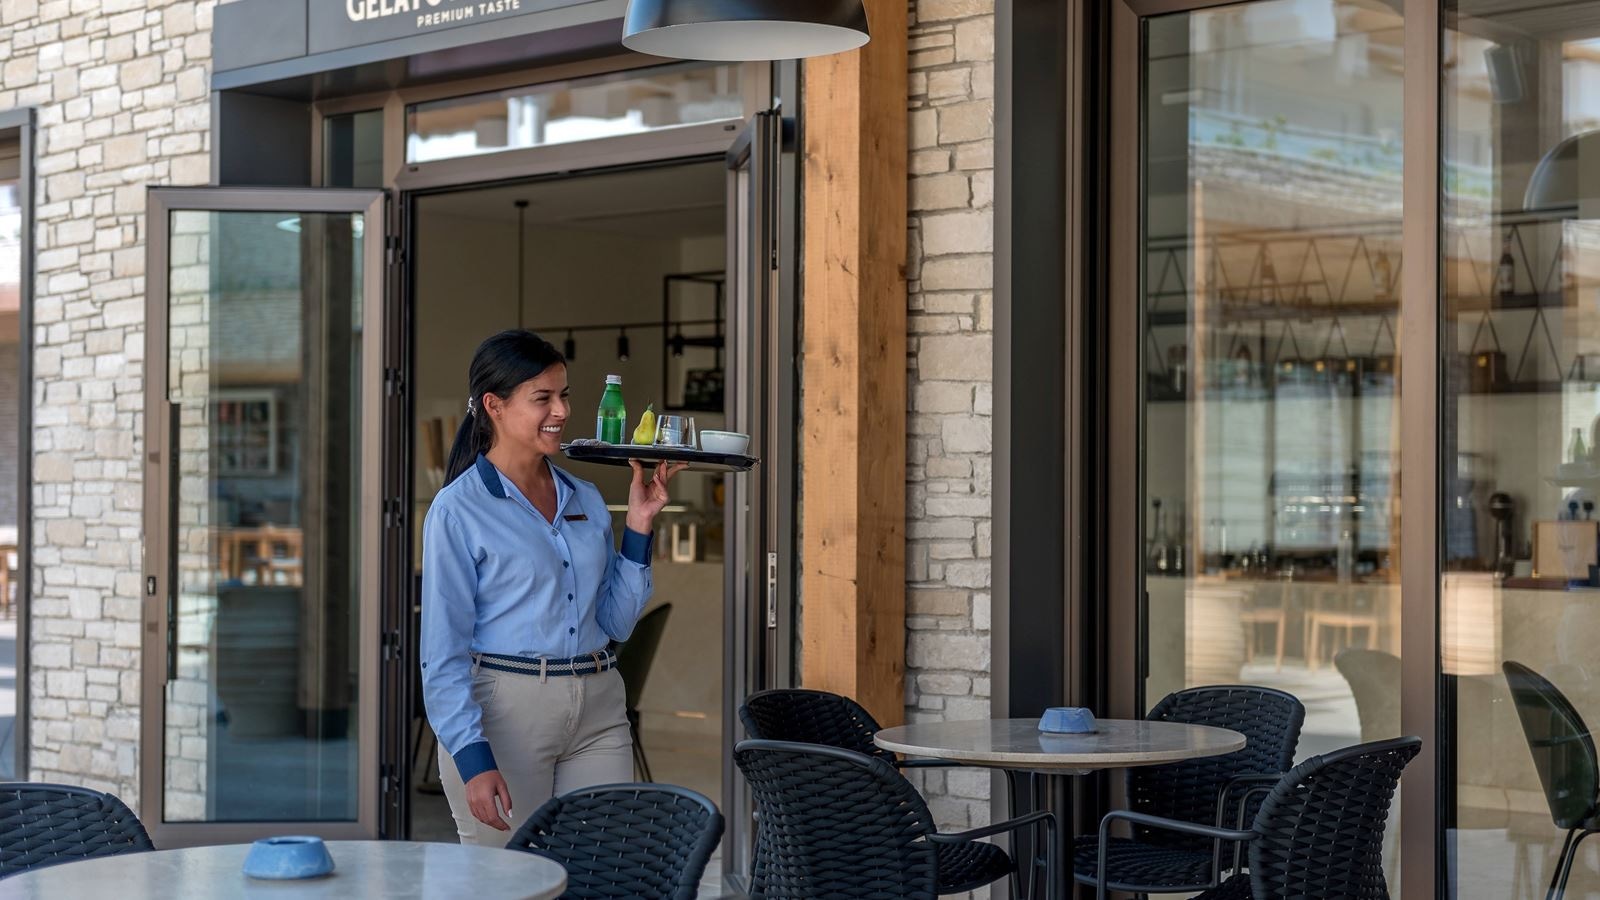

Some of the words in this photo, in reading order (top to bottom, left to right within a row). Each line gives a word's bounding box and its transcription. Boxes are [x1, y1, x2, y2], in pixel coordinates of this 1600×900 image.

[346, 0, 443, 21] GELA
[416, 6, 474, 28] PREMIUM
[478, 0, 520, 16] TASTE
